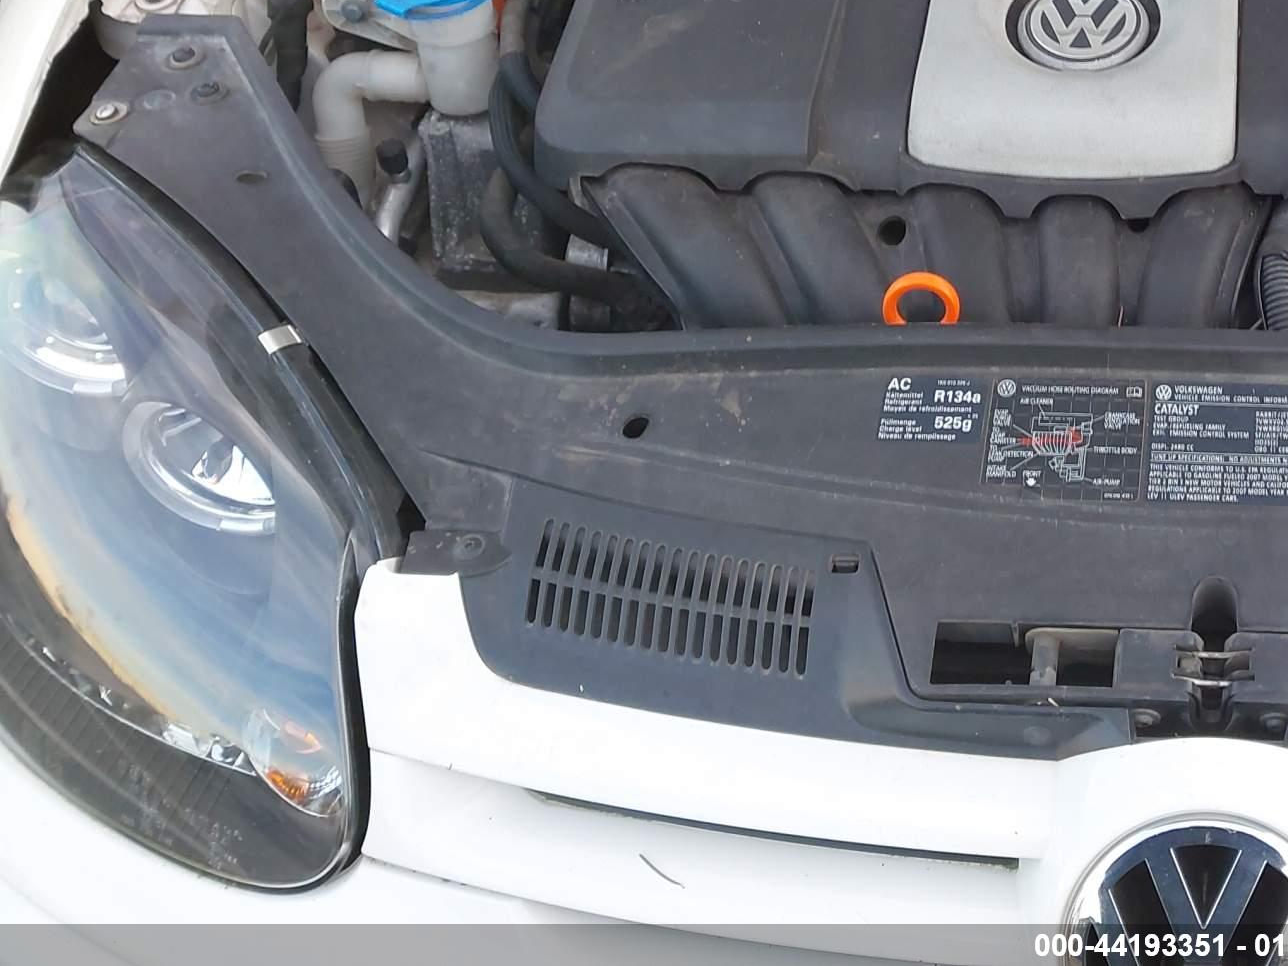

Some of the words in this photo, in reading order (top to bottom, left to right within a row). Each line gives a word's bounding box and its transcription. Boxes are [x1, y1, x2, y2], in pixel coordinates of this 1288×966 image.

[888, 377, 912, 391] AC
[1021, 385, 1047, 393] VACUUM
[1091, 386, 1119, 395] DIAGRAM
[1174, 385, 1223, 395] VOLKSWAGEN
[934, 389, 981, 404] R134a
[1174, 393, 1198, 401] VEHICLE
[1201, 394, 1230, 402] EMISSION
[1233, 395, 1260, 403] CONTROL
[1154, 403, 1200, 416] CATALYST
[934, 415, 972, 433] 525g
[904, 432, 913, 440] de
[1169, 429, 1198, 438] EMISSION
[1199, 430, 1226, 439] CONTROL
[1227, 431, 1250, 439] SYSTEM
[1093, 445, 1121, 454] THROTTLE
[1121, 446, 1138, 455] BODY
[1190, 464, 1224, 472] CONFORMS
[1193, 471, 1222, 479] GASOLINE
[1200, 479, 1222, 487] MOTOR
[1223, 480, 1251, 488] VEHICLES
[1148, 484, 1187, 493] REGULATIONS
[1188, 486, 1222, 494] APPLICABLE
[1232, 487, 1247, 495] 2007
[1247, 488, 1269, 496] MODEL
[1147, 492, 1159, 500] LEV
[1169, 492, 1185, 501] ULEV
[1186, 494, 1221, 502] PASSENGER
